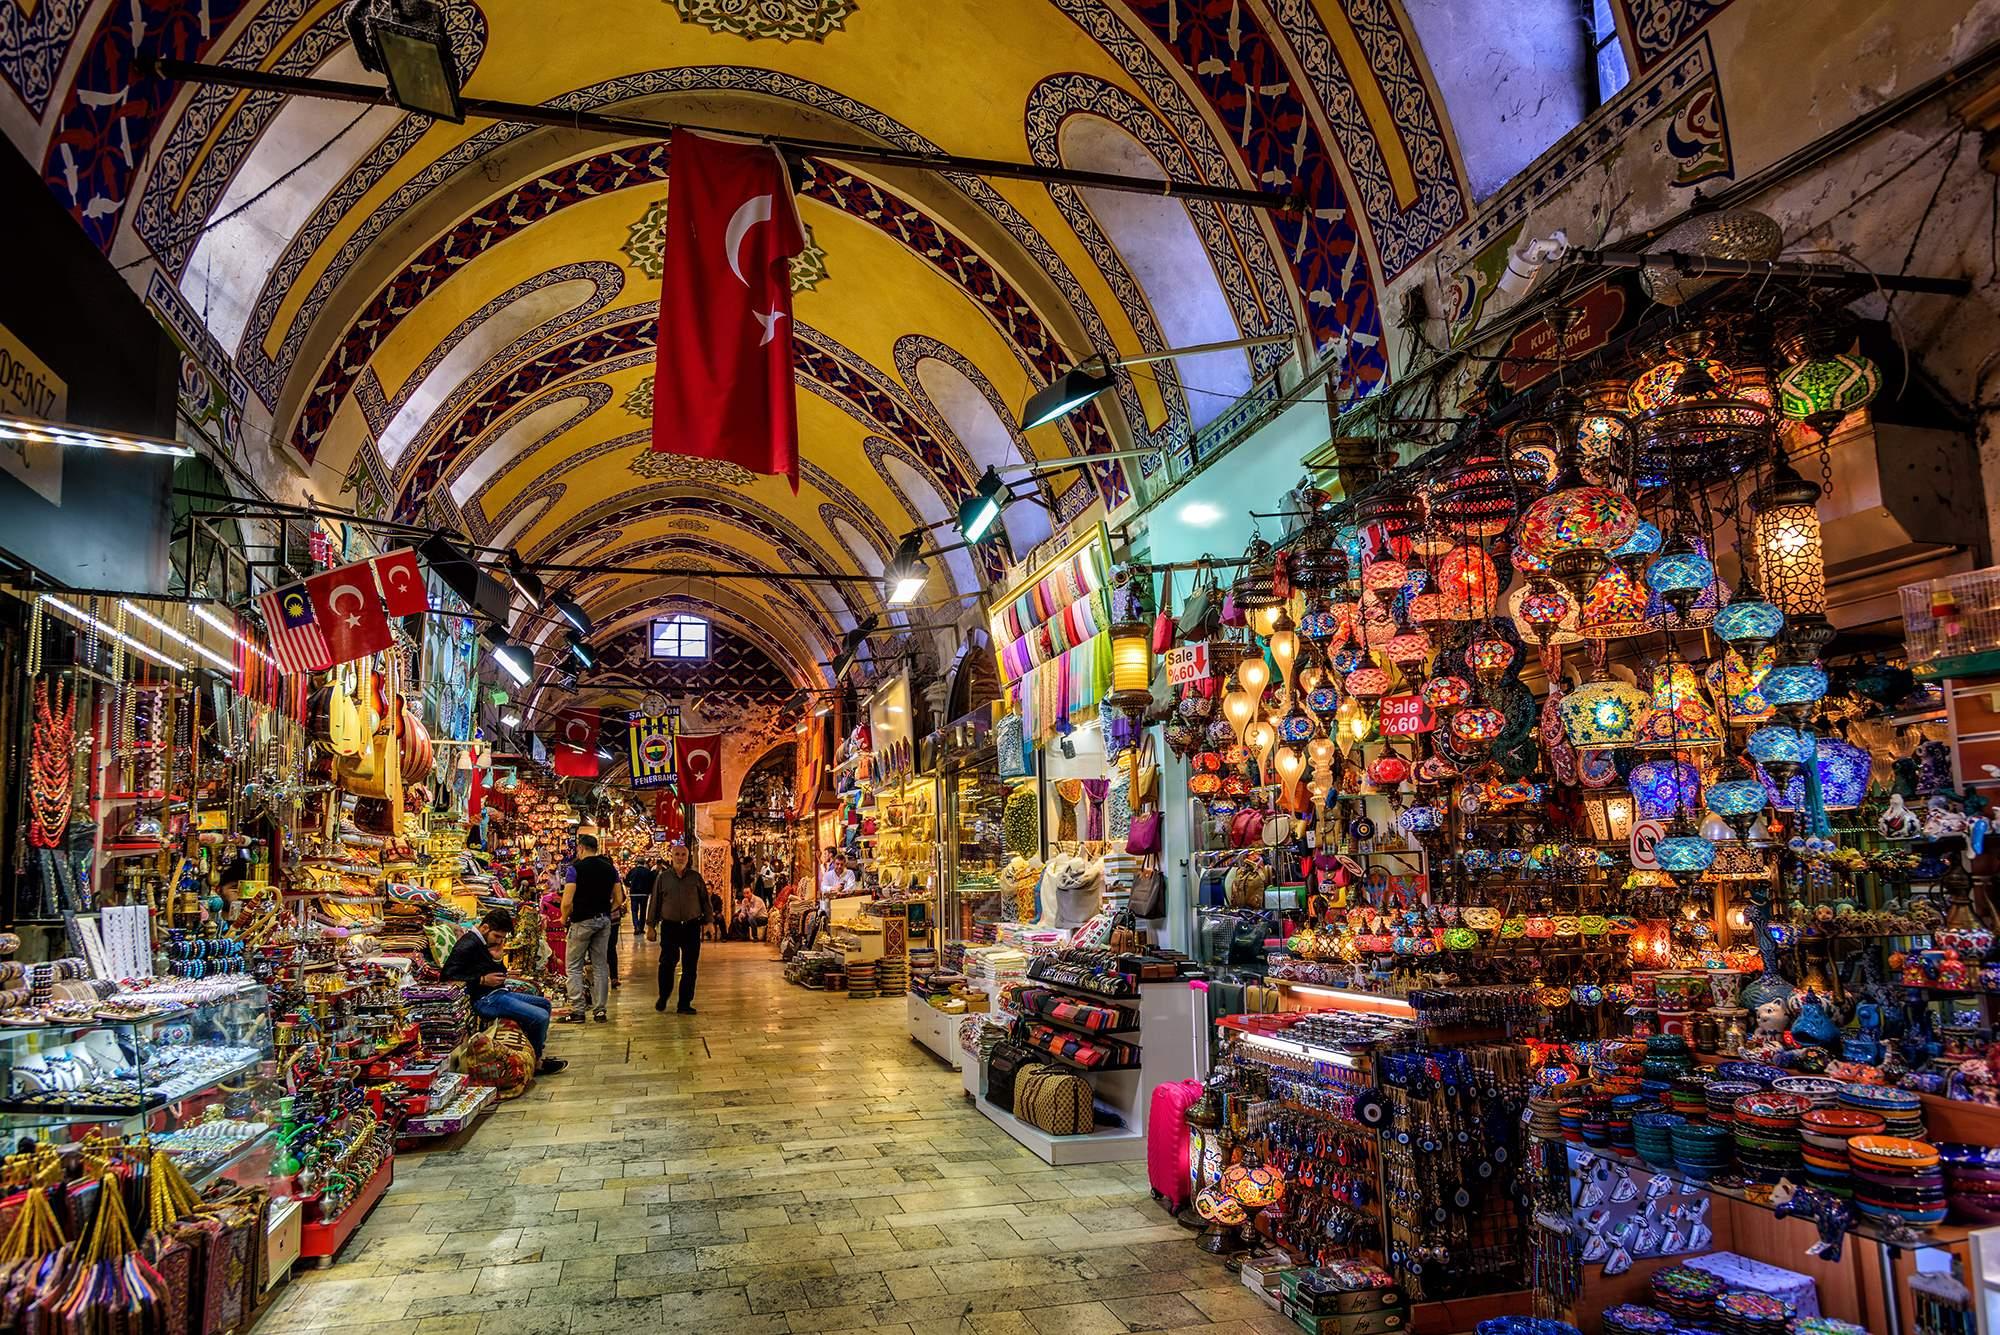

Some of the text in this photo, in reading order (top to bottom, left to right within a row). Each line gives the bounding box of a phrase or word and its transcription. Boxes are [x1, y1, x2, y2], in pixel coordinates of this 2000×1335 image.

[1167, 649, 1193, 666] Sale
[1167, 664, 1195, 683] %60
[1383, 699, 1419, 715] Sale
[1382, 716, 1419, 733] %60
[634, 773, 678, 786] FENERBAHÇ
